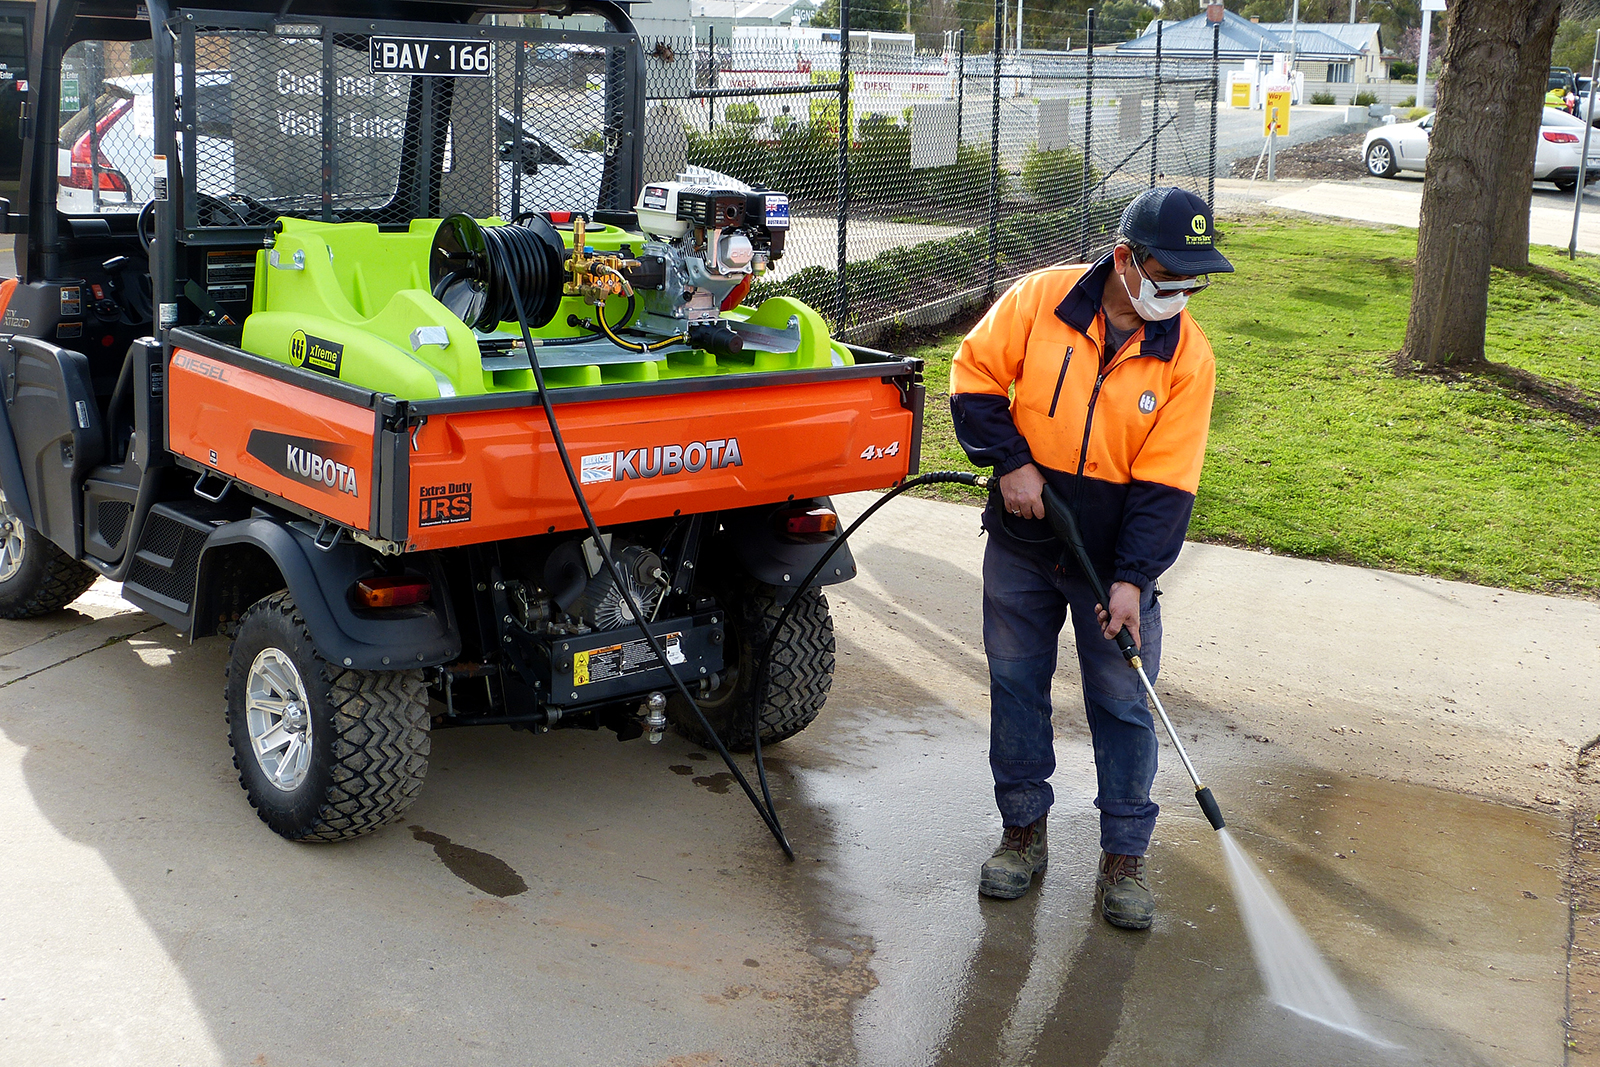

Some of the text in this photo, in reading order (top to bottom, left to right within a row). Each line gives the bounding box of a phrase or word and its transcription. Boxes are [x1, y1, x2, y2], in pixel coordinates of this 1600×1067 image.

[793, 8, 816, 21] SIGNS
[373, 41, 382, 68] VIC
[382, 42, 490, 71] BAV 166
[276, 68, 378, 96] Custmer
[276, 109, 344, 137] Visitr
[174, 354, 229, 382] DIESEL
[614, 437, 743, 482] KUBOTA
[860, 441, 900, 460] 4x4
[286, 443, 359, 498] KUBOTA
[420, 483, 472, 497] Extra Duty
[421, 496, 470, 520] IRS
